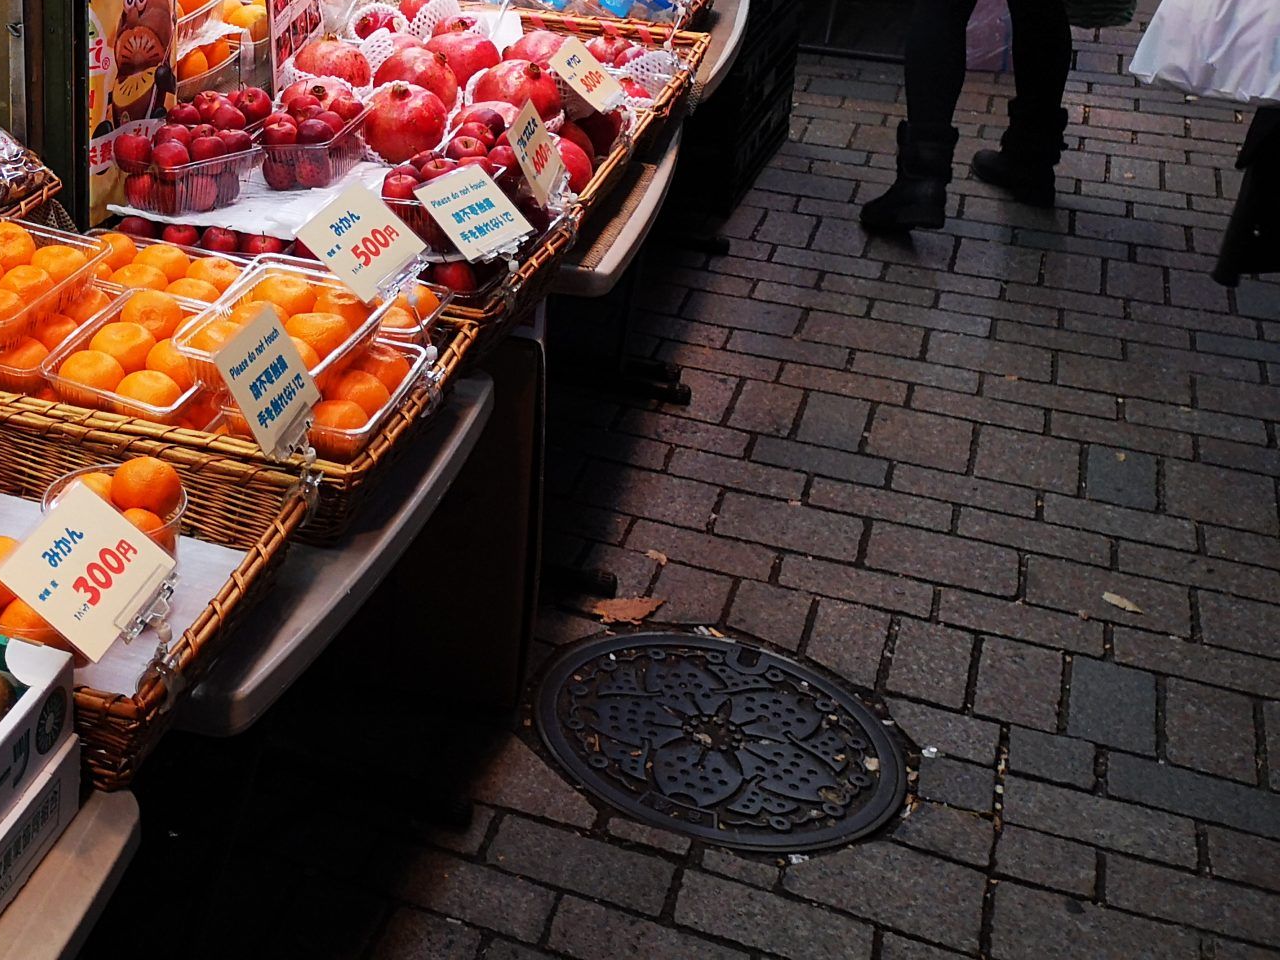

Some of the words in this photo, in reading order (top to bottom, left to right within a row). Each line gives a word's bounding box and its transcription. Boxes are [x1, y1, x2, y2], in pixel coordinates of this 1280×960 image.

[581, 70, 604, 92] 800円
[532, 146, 552, 175] 600円
[431, 193, 451, 208] Please
[460, 186, 470, 198] not
[470, 179, 488, 195] touch
[329, 210, 360, 233] みかん
[351, 224, 400, 267] 500円
[229, 358, 248, 380] Please
[265, 327, 280, 346] touch
[257, 373, 305, 428] 手を触れないで
[42, 527, 84, 568] みかん
[72, 539, 138, 606] 300円
